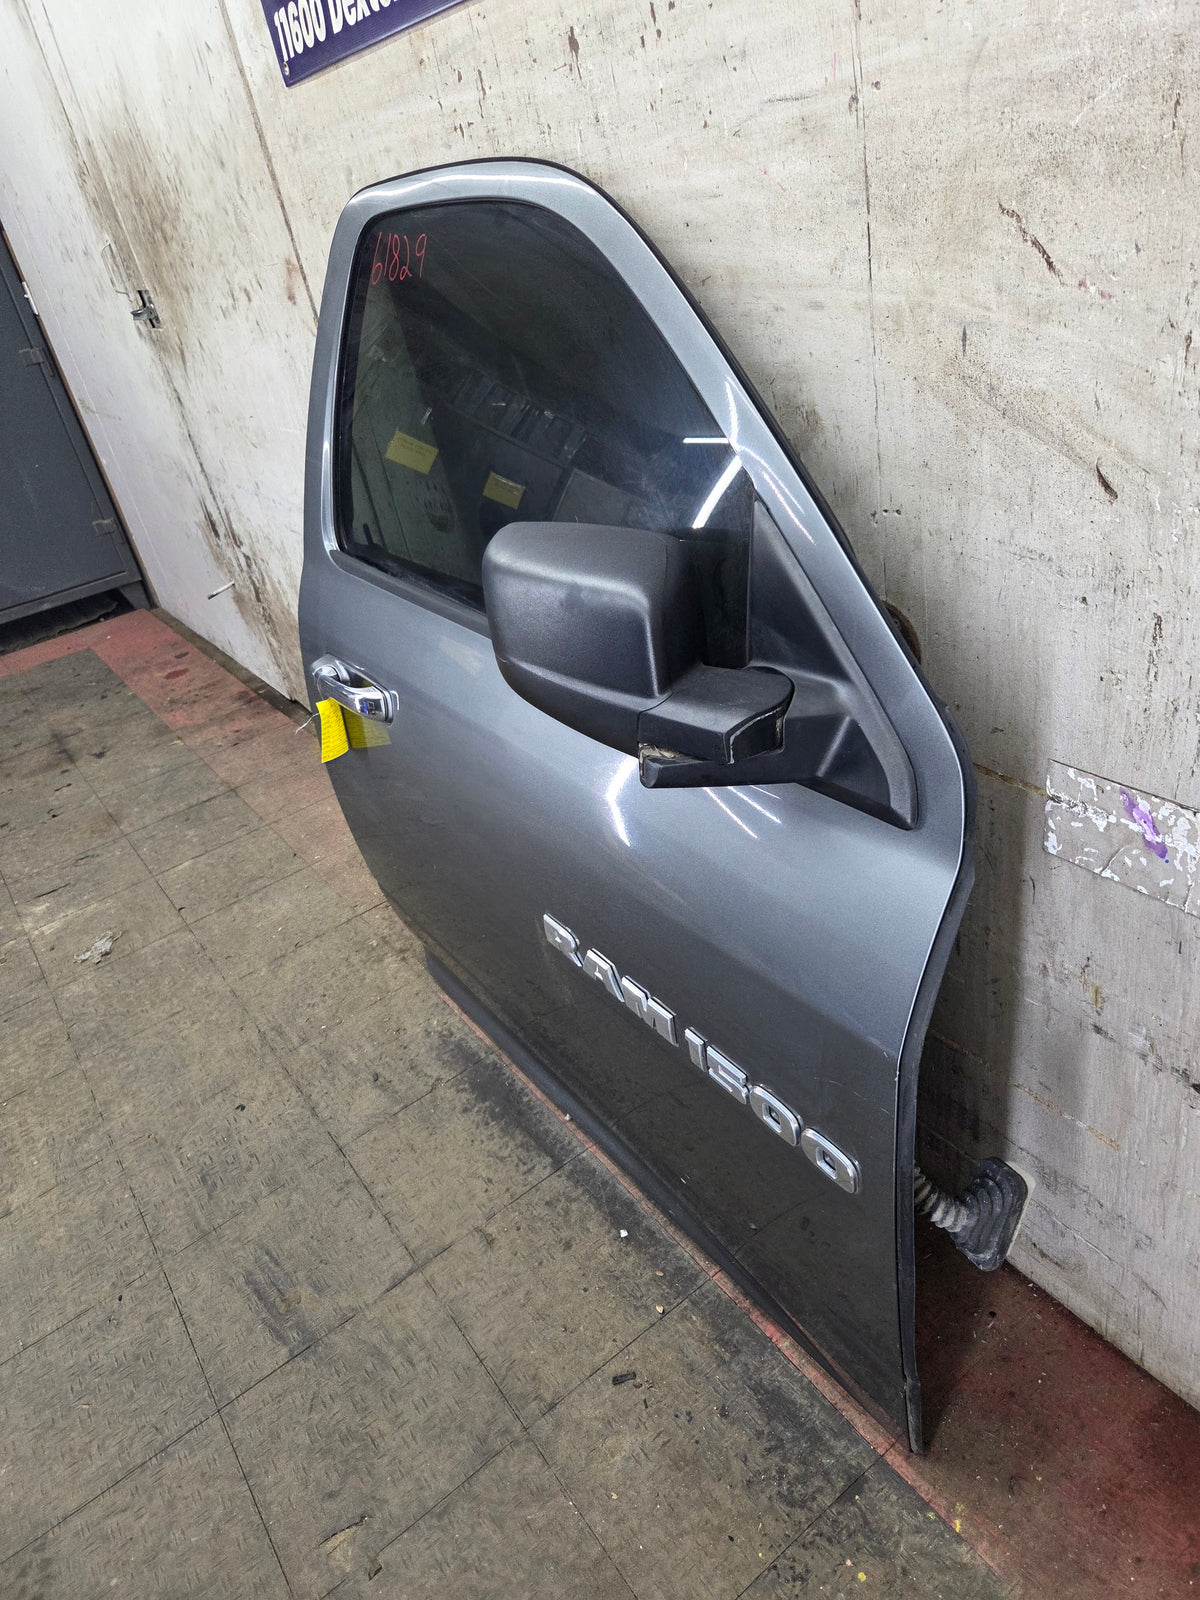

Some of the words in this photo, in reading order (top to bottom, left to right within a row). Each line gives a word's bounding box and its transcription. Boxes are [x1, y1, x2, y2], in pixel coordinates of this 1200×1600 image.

[273, 0, 327, 62] 11600
[327, 0, 399, 35] Dex
[371, 231, 428, 285] 61829
[543, 913, 679, 1048] RAM
[685, 1027, 863, 1195] 1500
